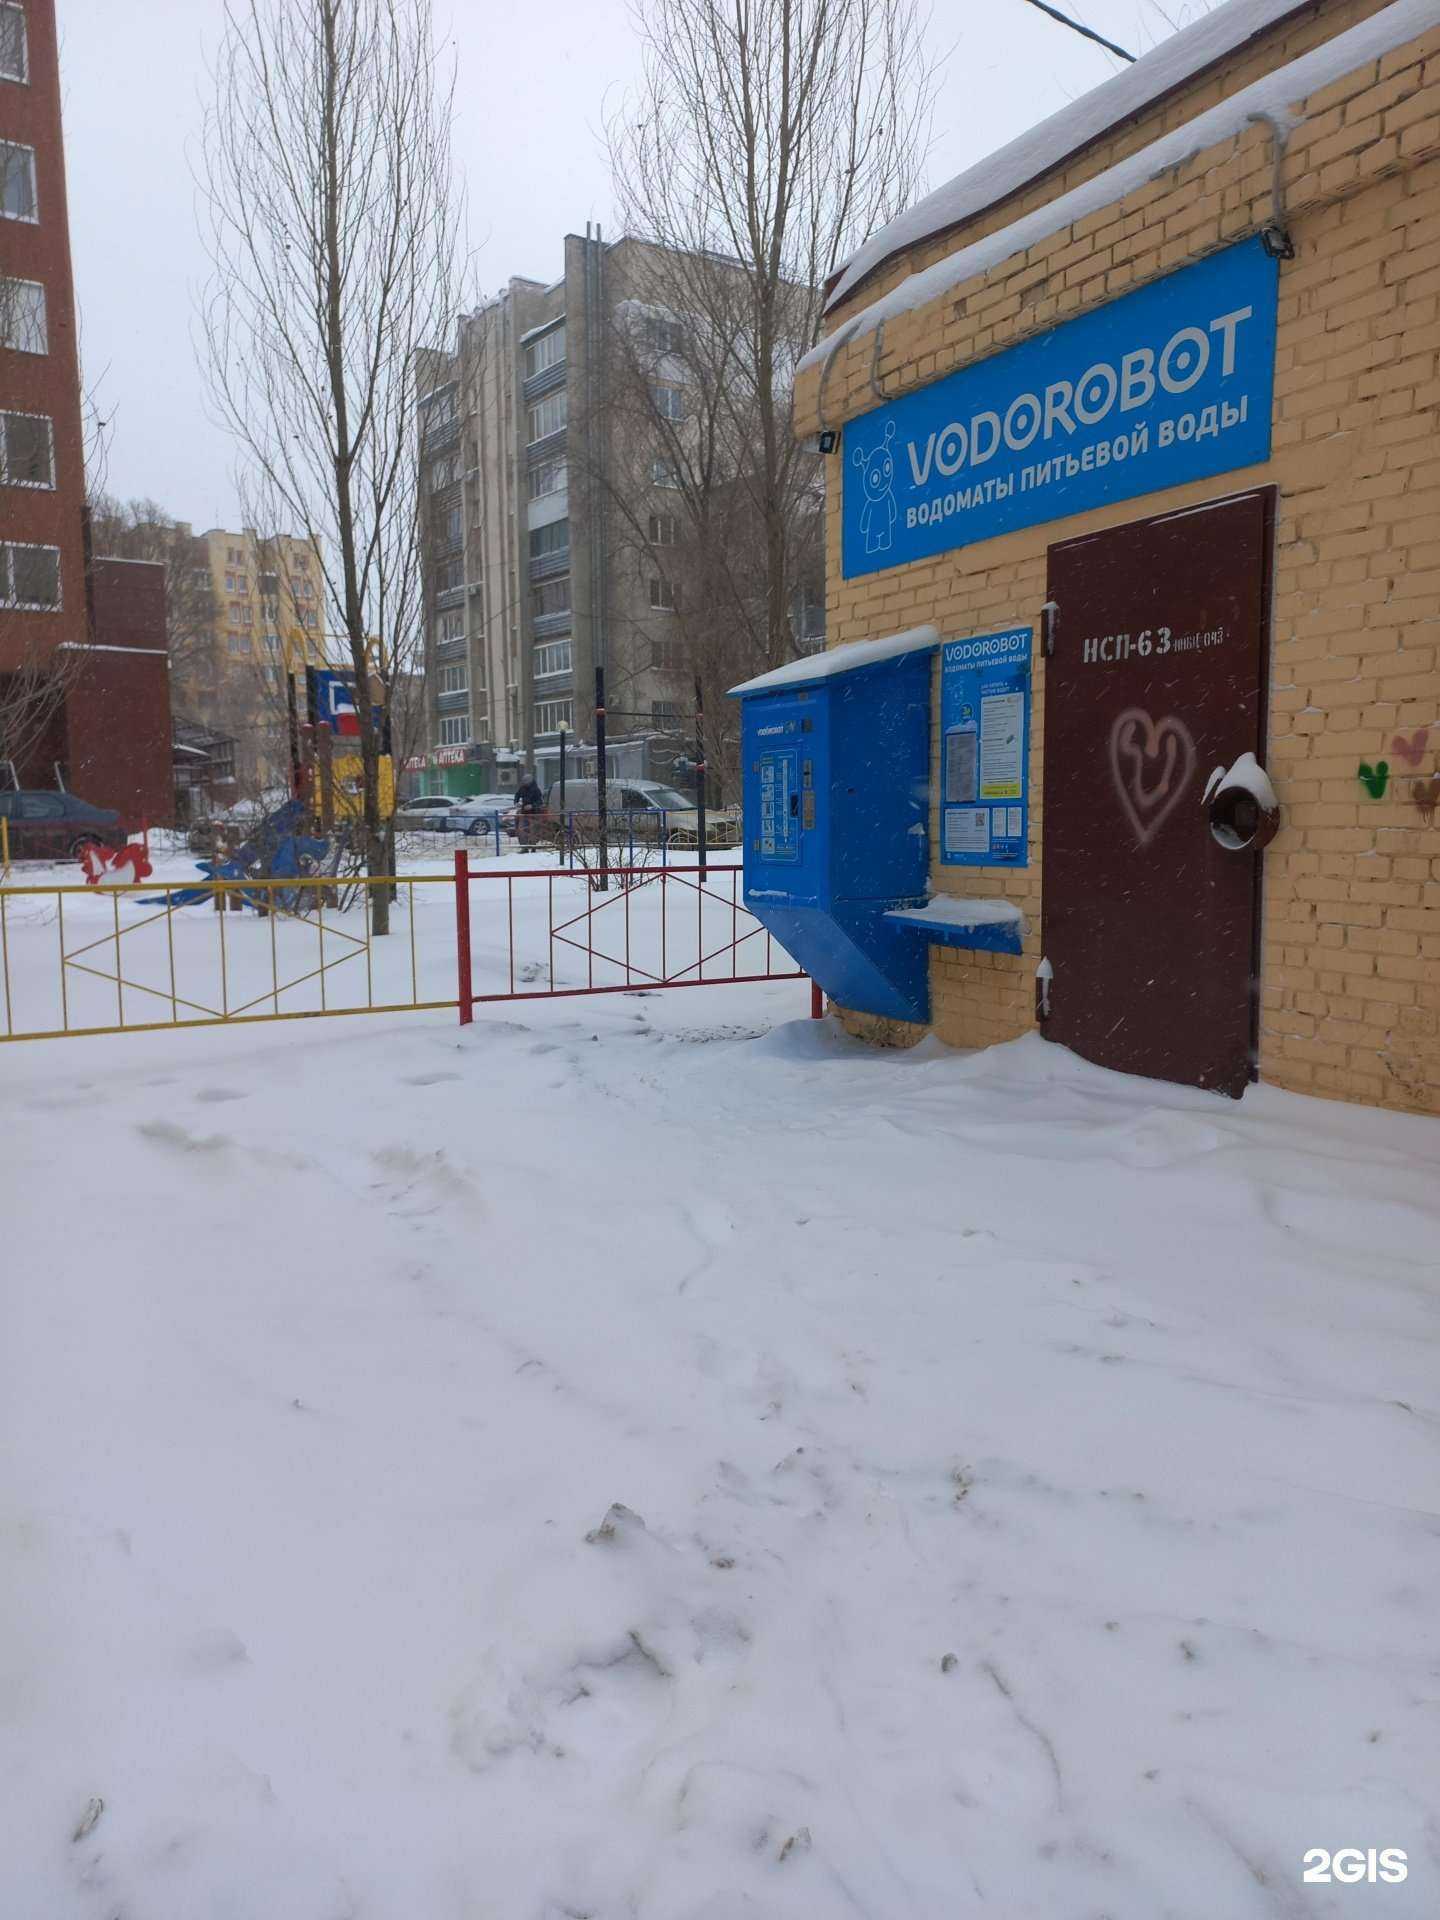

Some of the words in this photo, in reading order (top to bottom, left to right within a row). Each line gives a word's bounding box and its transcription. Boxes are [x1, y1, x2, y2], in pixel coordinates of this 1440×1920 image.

[907, 305, 1252, 486] VODOROBOT
[906, 472, 1014, 529] ВОДОМАТЫ
[1020, 421, 1149, 492] ПИТЬЕВОЙ
[1158, 395, 1249, 449] ВОДЫ
[945, 633, 1028, 662] VODOROBOT
[438, 750, 465, 764] АПТЕКА
